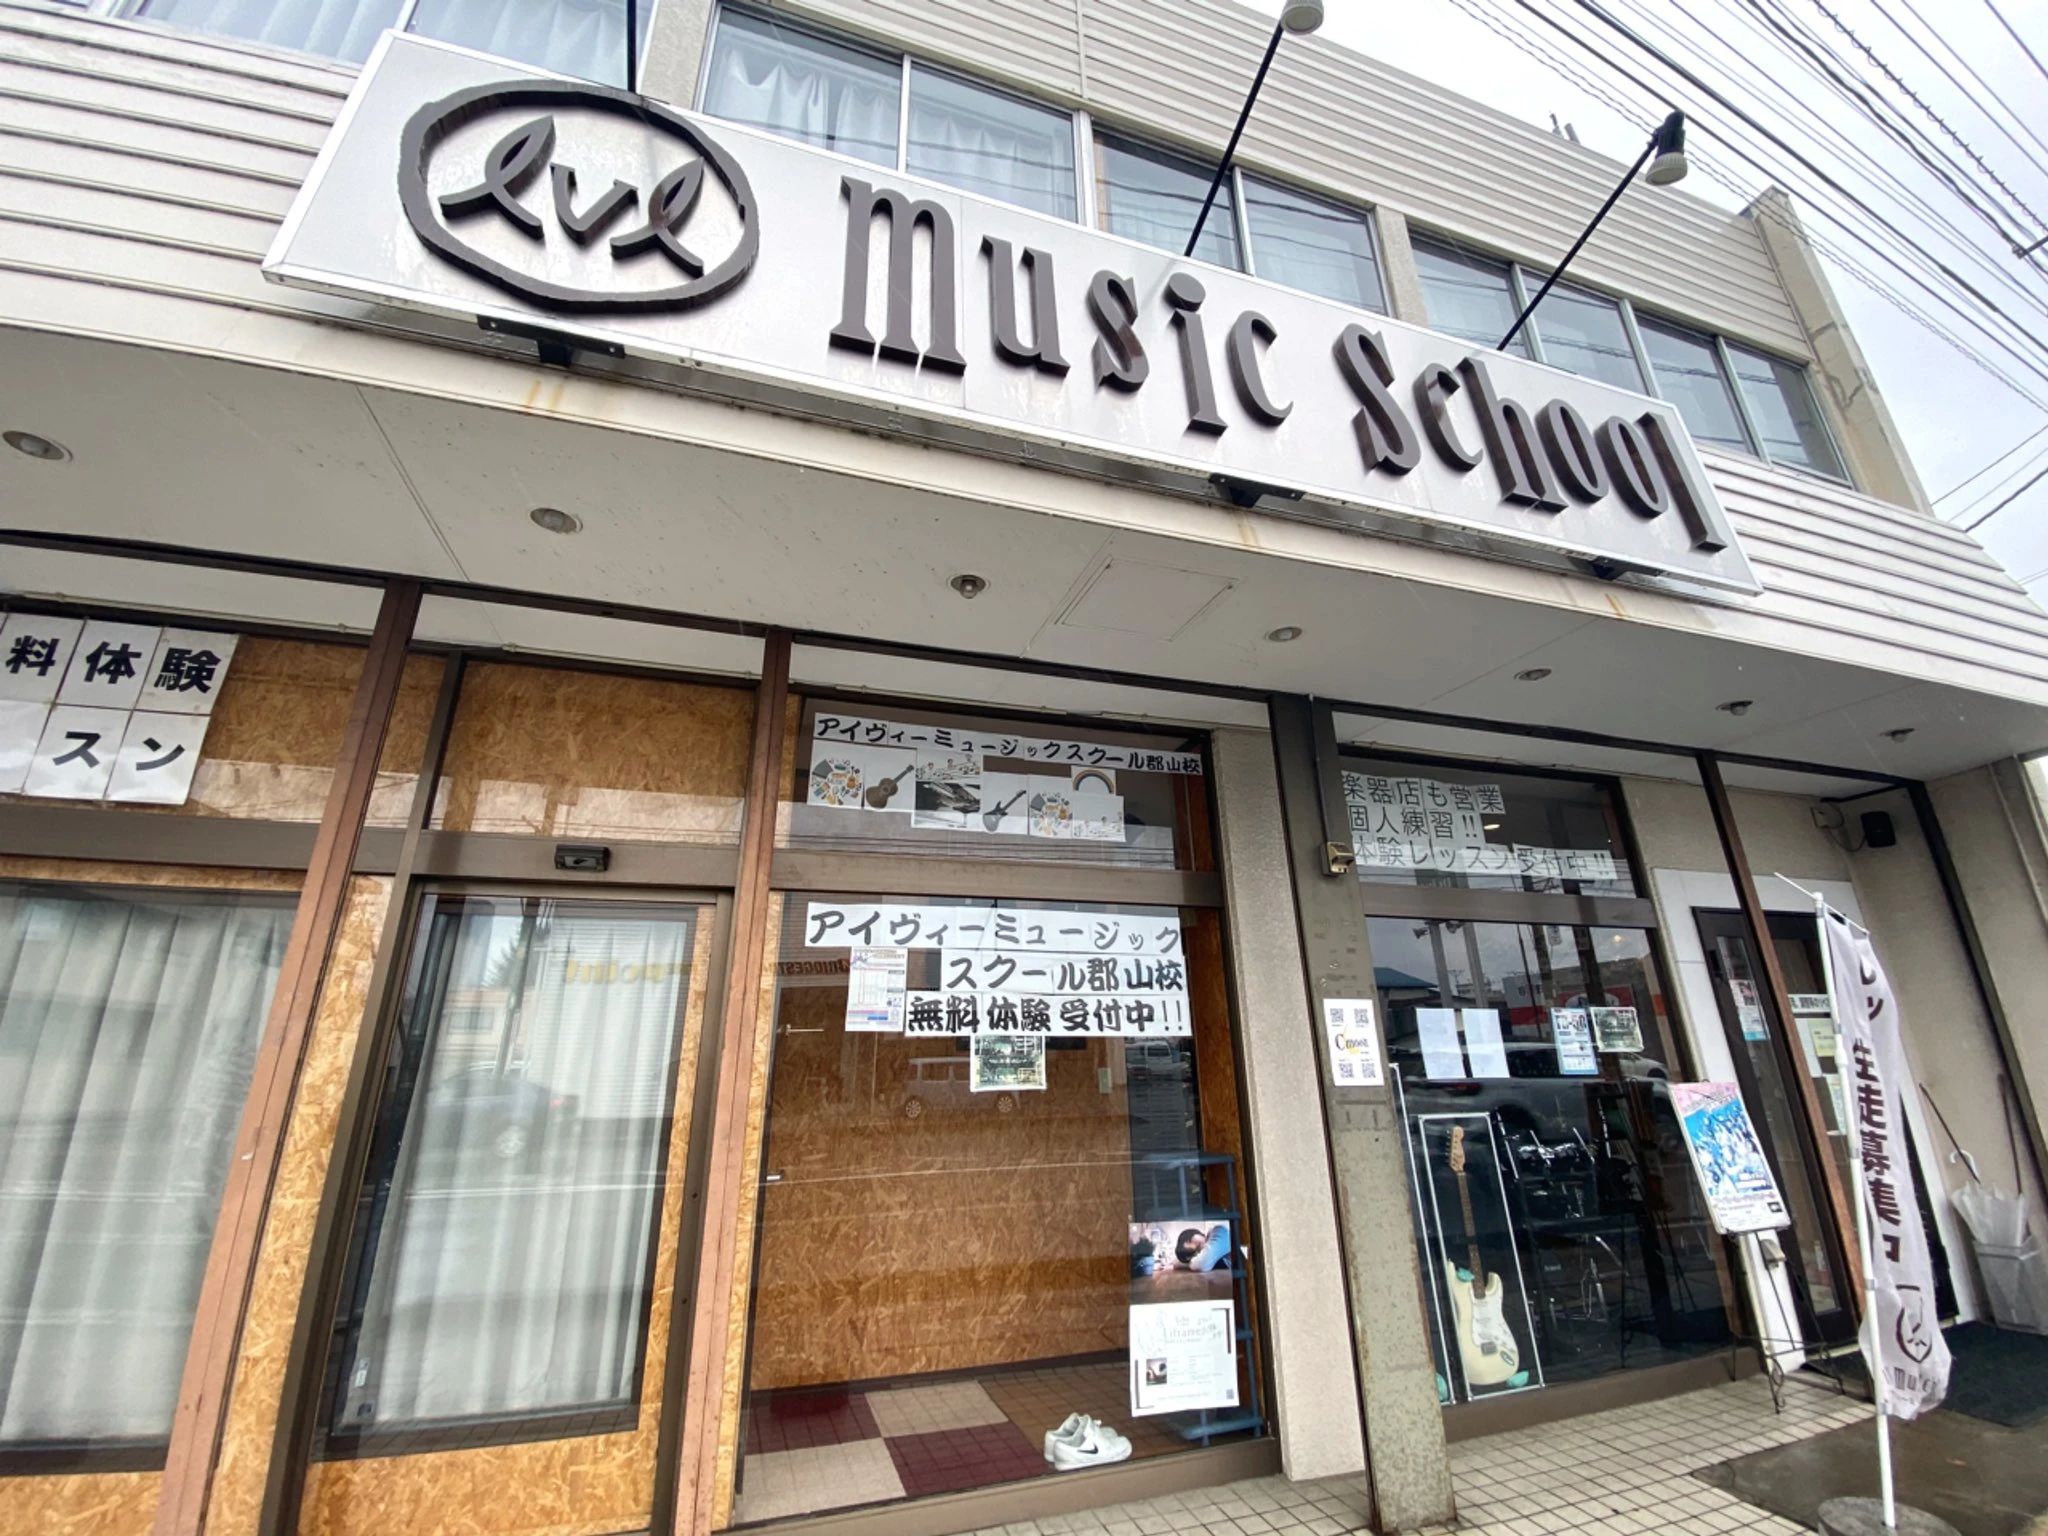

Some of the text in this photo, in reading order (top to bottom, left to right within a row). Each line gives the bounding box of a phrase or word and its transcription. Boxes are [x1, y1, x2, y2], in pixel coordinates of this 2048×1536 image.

[1332, 322, 1728, 553] School
[5, 635, 222, 694] 料体験
[52, 730, 185, 772] スン
[1344, 772, 1501, 813] 楽器店も営業
[809, 910, 1180, 952] アイヴィーミュージック
[946, 954, 1184, 992] スクール郡山校
[908, 994, 1183, 1033] 無料体験受付中!!
